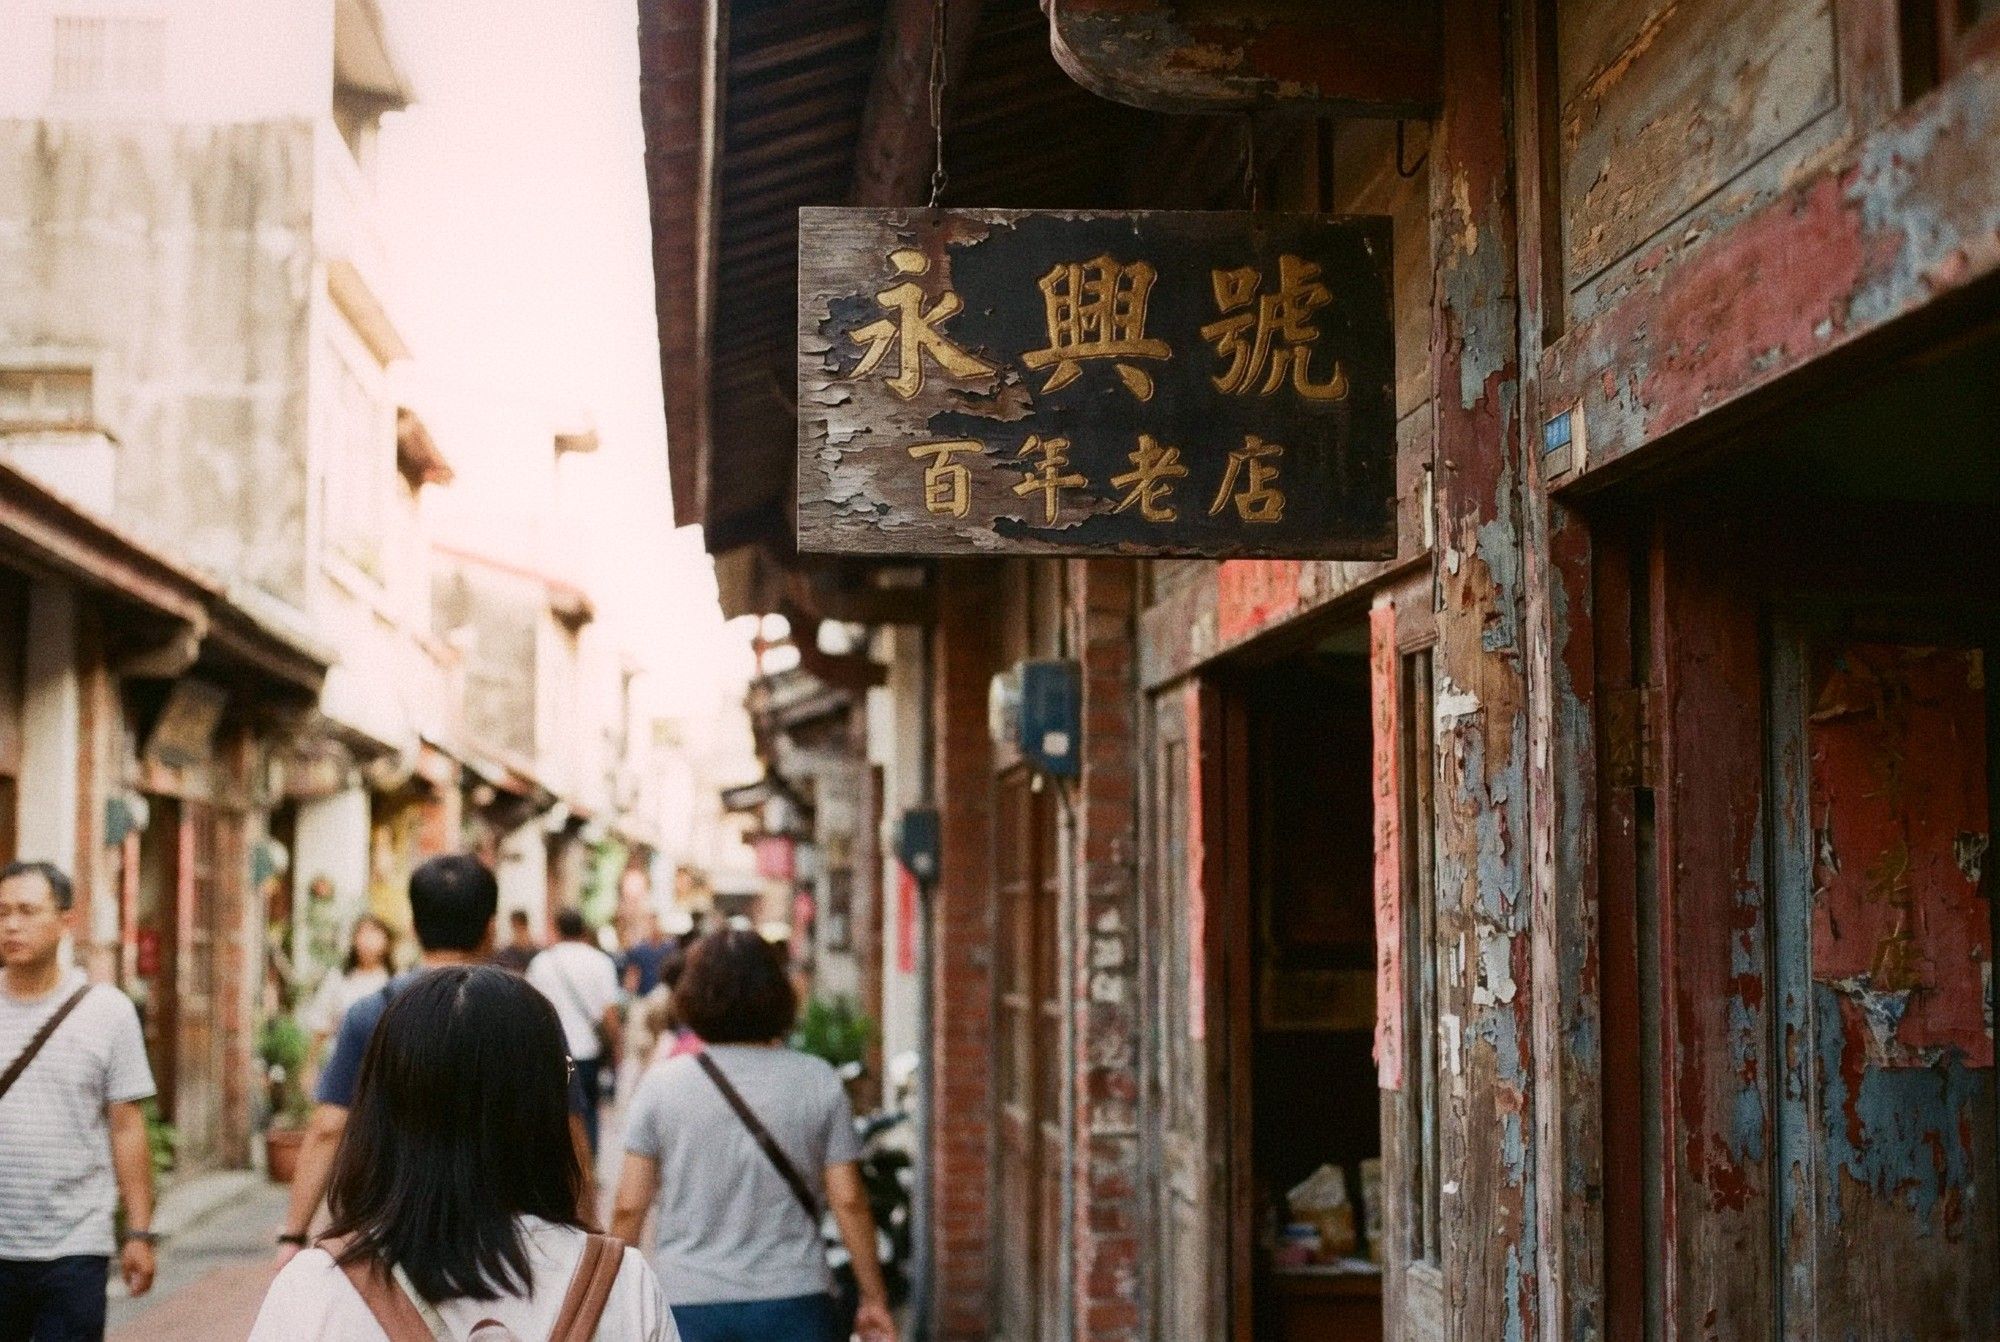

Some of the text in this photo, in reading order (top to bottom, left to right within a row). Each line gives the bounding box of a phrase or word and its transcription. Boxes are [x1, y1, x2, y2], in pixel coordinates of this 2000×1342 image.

[848, 247, 1349, 401] 永興號
[908, 434, 1287, 525] 百年老店
